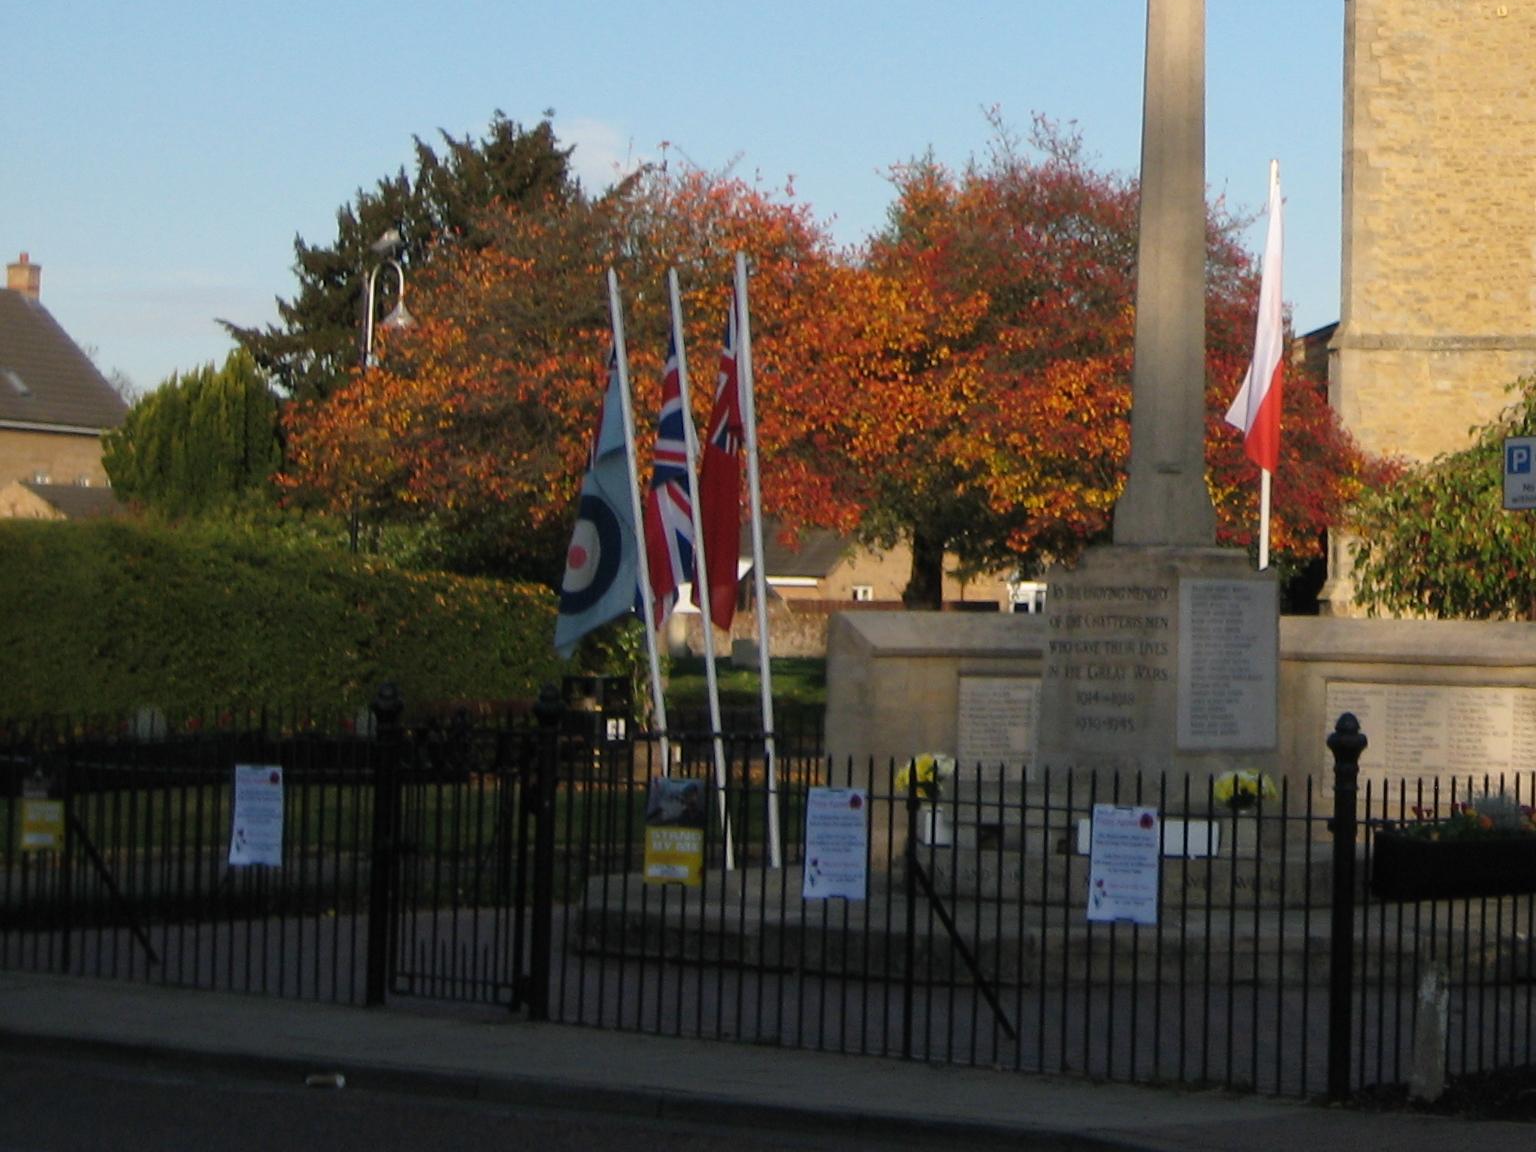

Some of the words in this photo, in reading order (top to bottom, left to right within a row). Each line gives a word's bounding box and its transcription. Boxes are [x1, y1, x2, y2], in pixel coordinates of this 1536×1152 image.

[1513, 449, 1527, 472] P
[1144, 616, 1168, 629] MEN
[1048, 640, 1072, 655] WHO
[1087, 663, 1126, 681] GREAT
[1134, 664, 1169, 680] WARS
